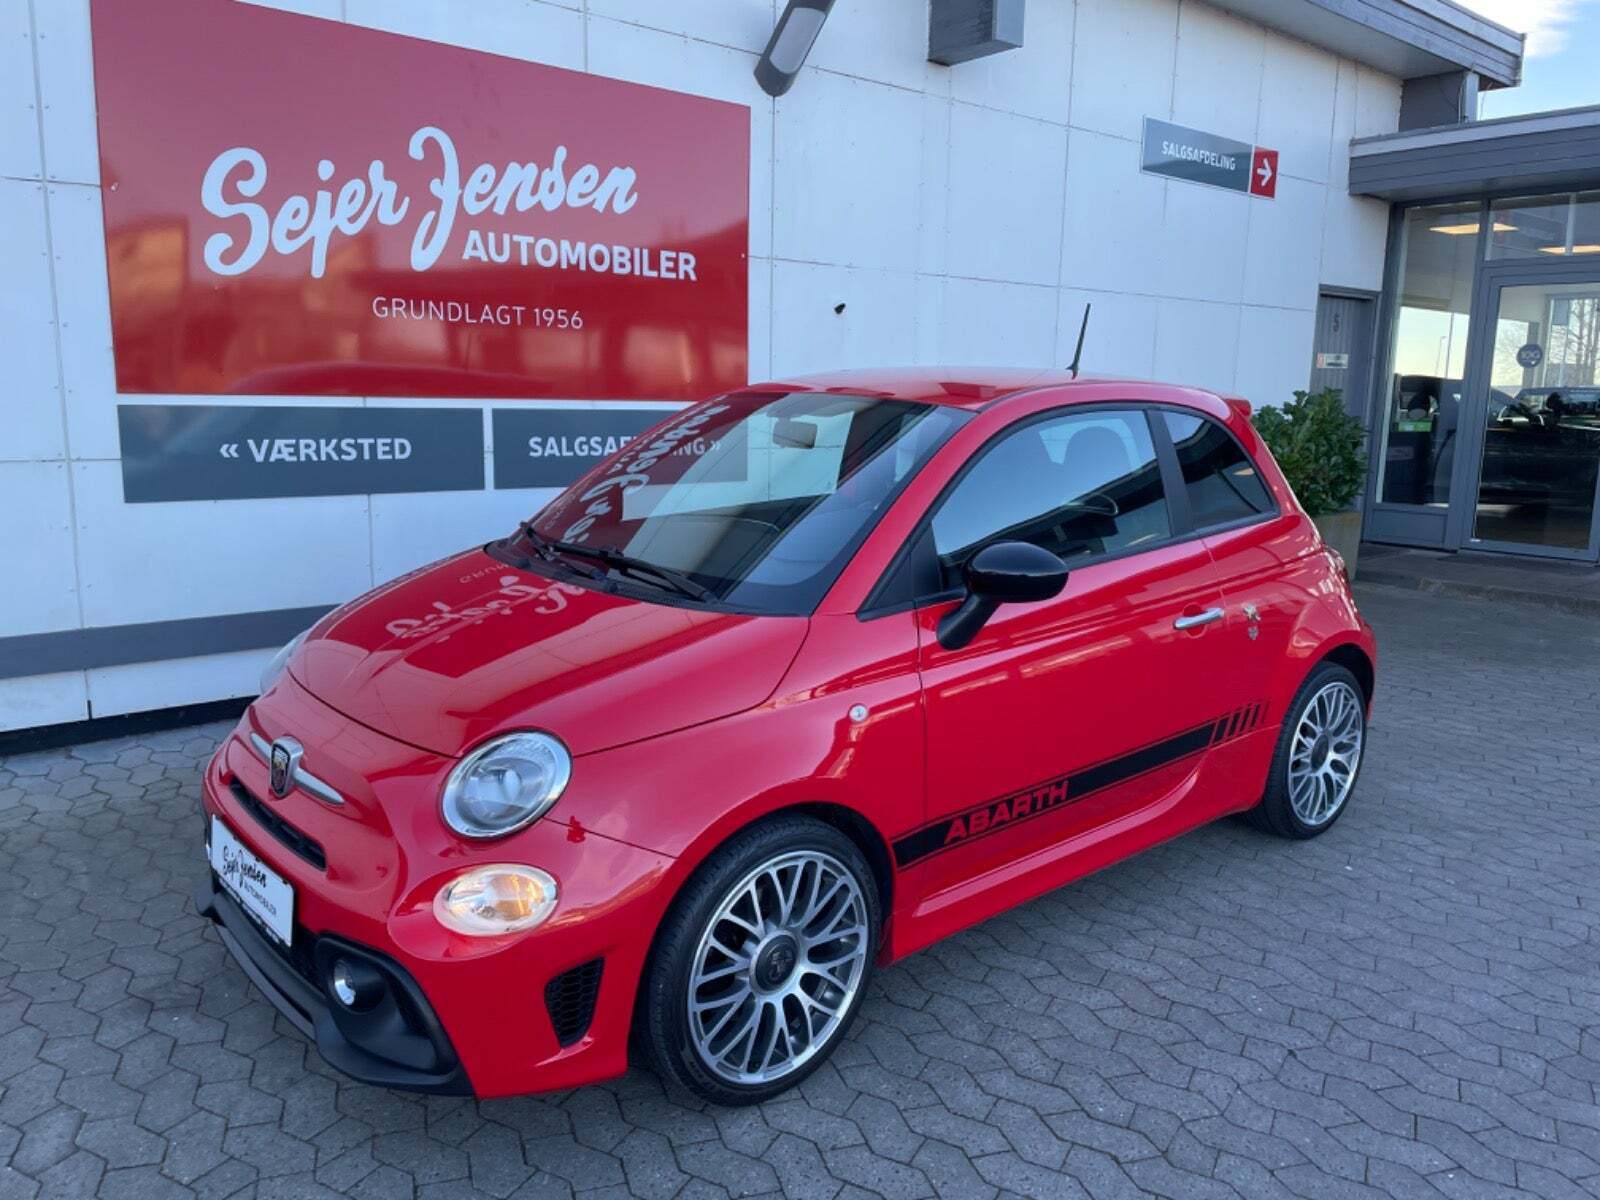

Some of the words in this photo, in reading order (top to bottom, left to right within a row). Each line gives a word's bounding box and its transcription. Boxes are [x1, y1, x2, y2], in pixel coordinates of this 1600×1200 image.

[1161, 140, 1236, 171] SALGSAFDELING
[201, 147, 409, 279] Sejer
[408, 126, 638, 272] Jensen
[462, 229, 697, 281] AUTOMOBILER
[372, 296, 525, 326] GRUNDLAGT
[533, 308, 584, 330] 1956
[247, 437, 412, 463] VÆRKSTED
[943, 779, 1070, 845] ABARTH
